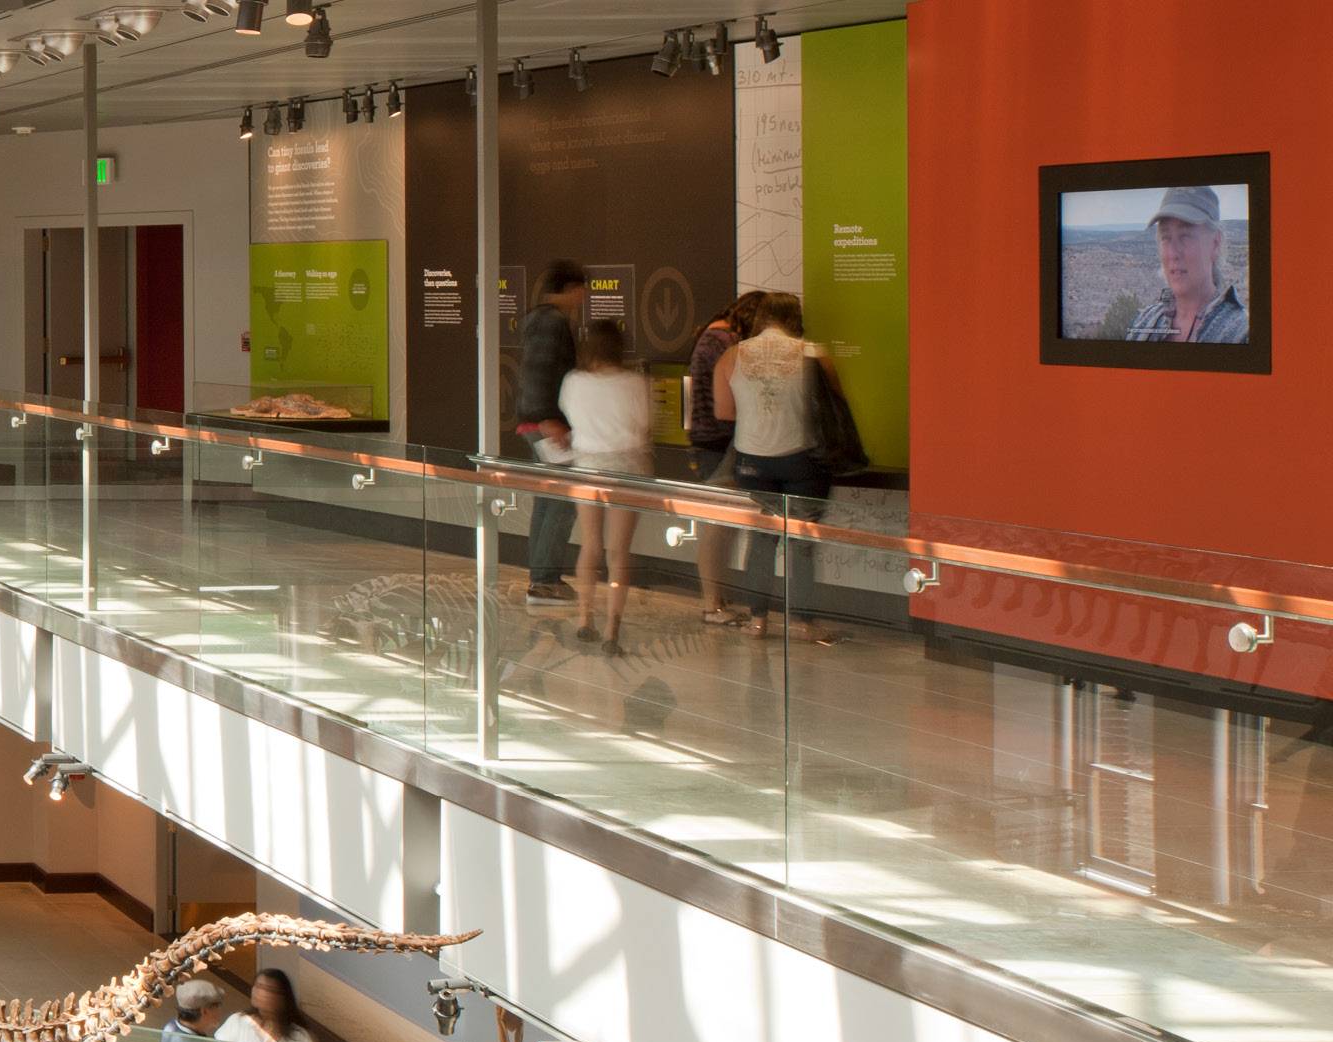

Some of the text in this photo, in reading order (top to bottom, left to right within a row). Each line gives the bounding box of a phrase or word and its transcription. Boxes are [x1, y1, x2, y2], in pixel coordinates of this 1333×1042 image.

[267, 140, 329, 158] Can tiny fossils lead
[267, 157, 331, 176] to giant discoveries?
[833, 224, 863, 234] Remote
[834, 235, 877, 248] expeditions
[424, 269, 452, 277] Discoveries,
[424, 279, 458, 288] then questions
[591, 280, 620, 291] CHART
